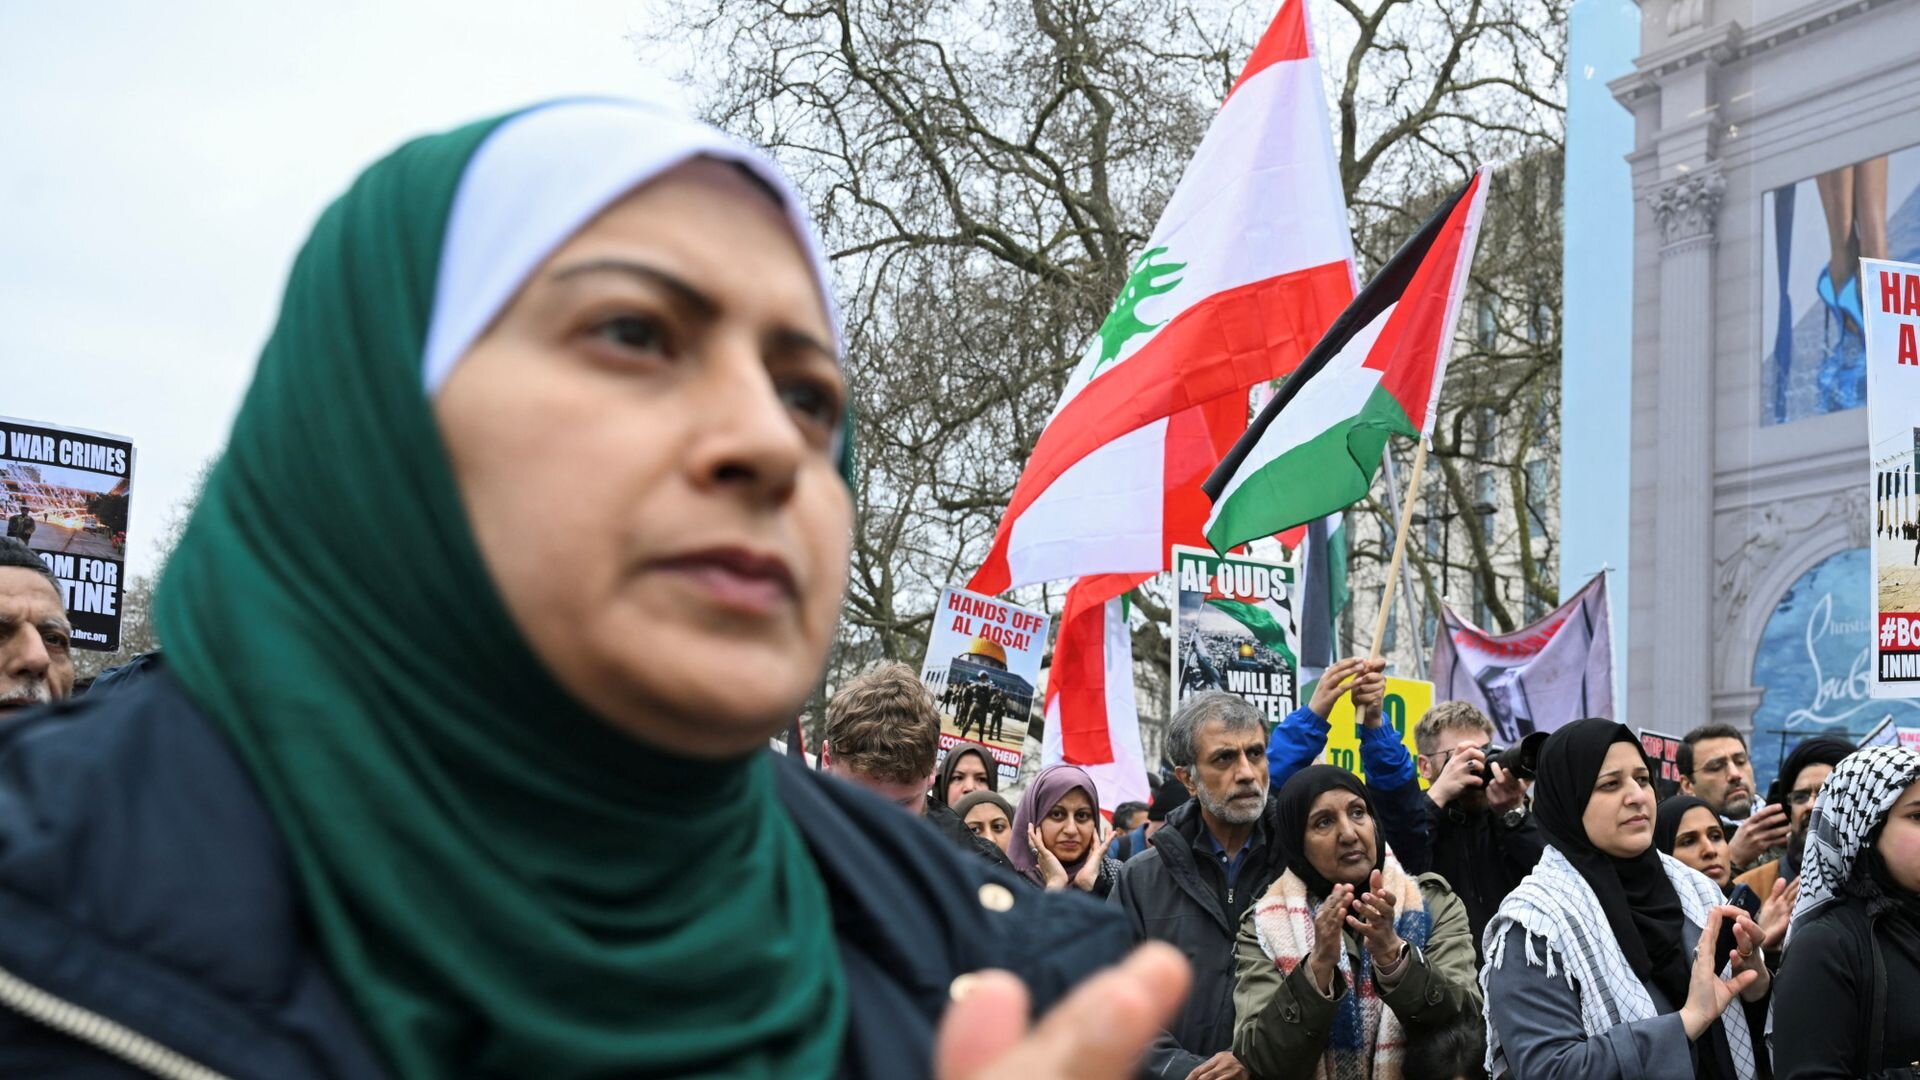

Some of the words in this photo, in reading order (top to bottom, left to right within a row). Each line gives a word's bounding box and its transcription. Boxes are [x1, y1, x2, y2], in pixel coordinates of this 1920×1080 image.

[1880, 271, 1920, 316] HA
[1898, 324, 1918, 366] A
[10, 431, 55, 462] WAR
[59, 439, 126, 474] CRIMES
[79, 558, 118, 585] FOR
[1180, 559, 1212, 593] AL
[1217, 562, 1287, 600] QUDS
[948, 592, 1008, 624] HANDS
[1012, 611, 1043, 634] OFF
[951, 615, 973, 636] AL
[1227, 670, 1268, 694] WILL
[1270, 673, 1292, 696] BE
